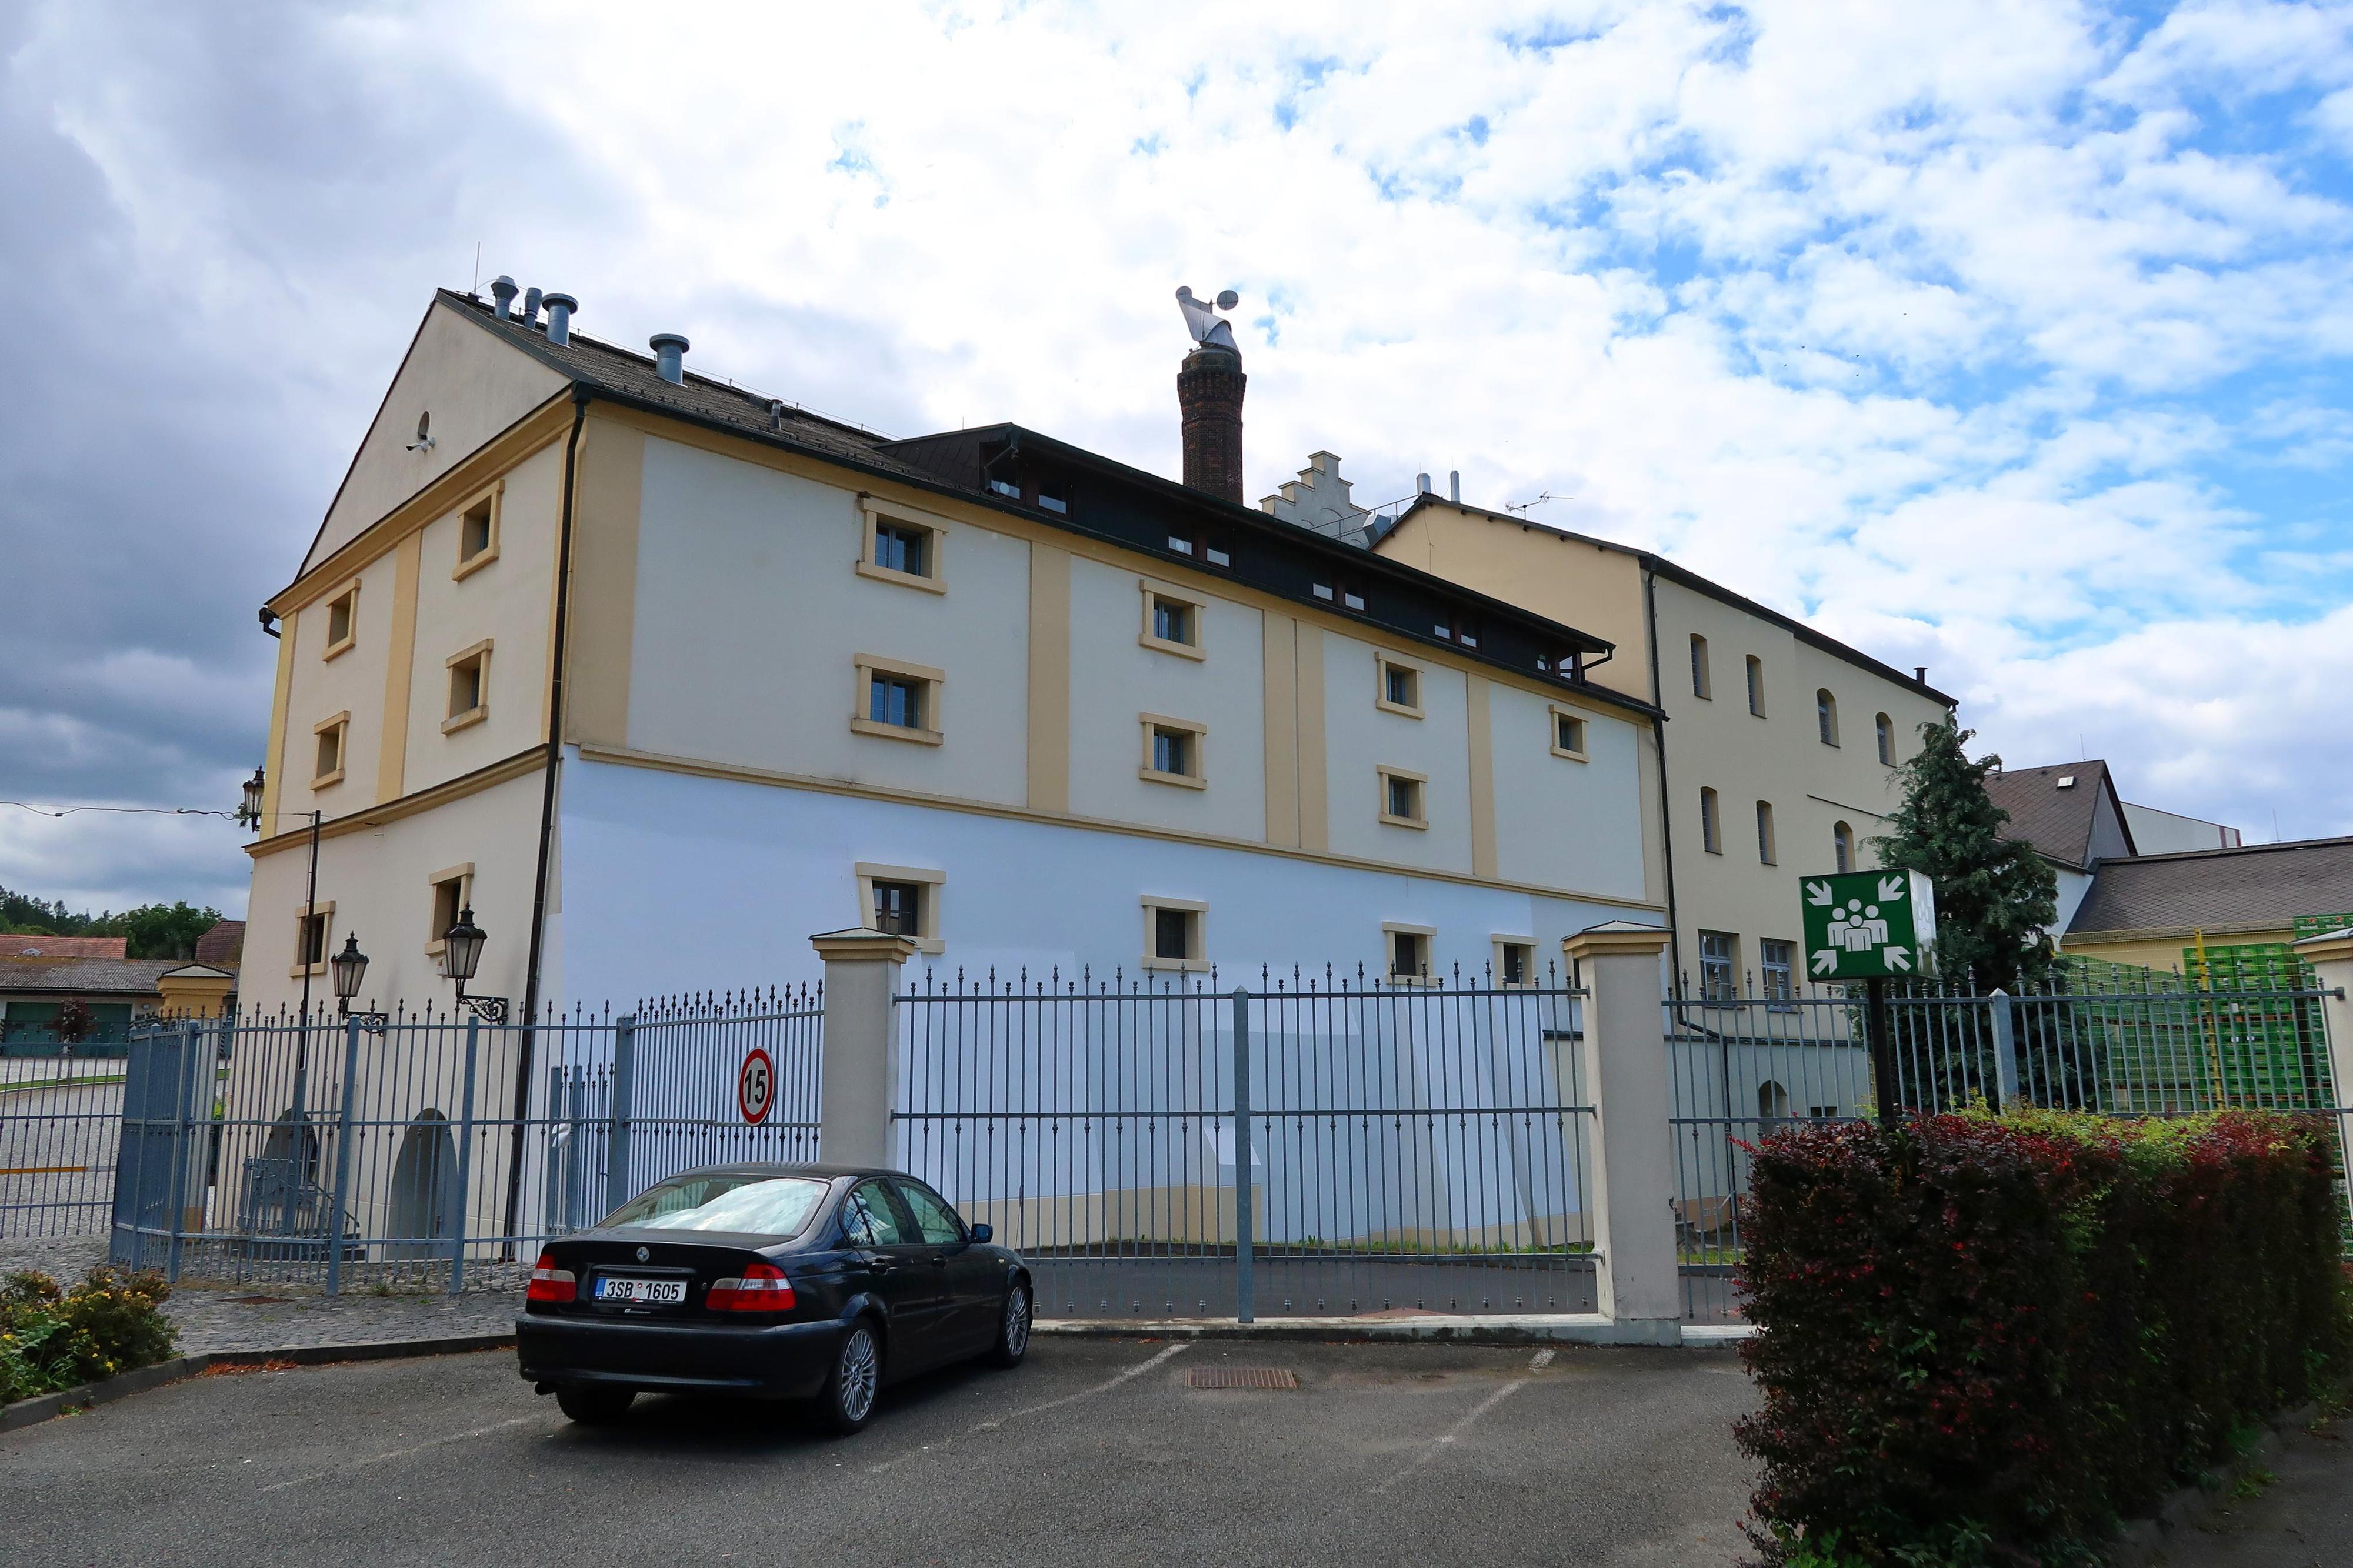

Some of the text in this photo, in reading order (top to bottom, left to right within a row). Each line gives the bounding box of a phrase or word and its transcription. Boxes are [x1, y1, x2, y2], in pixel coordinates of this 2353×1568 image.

[745, 1069, 766, 1104] 15
[606, 1281, 680, 1300] 3SB 1605
